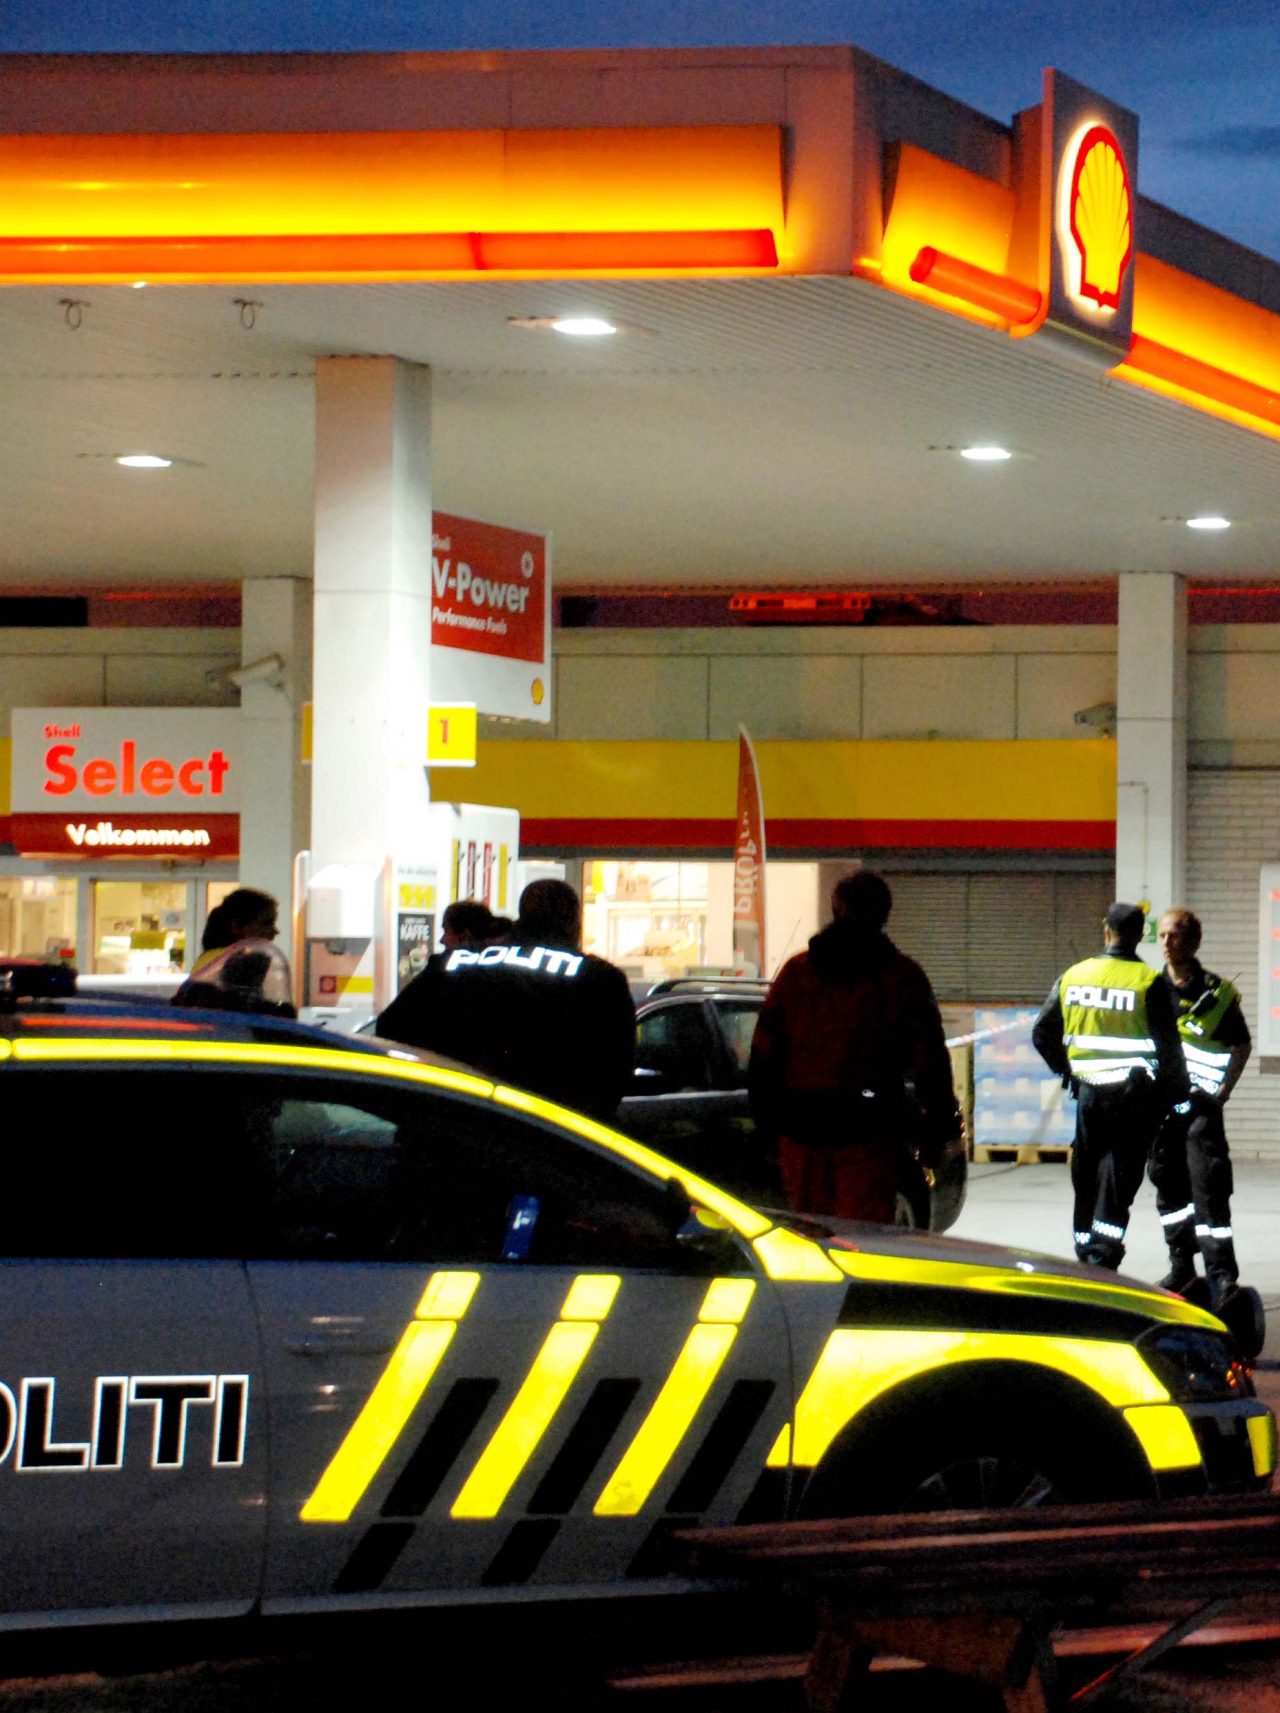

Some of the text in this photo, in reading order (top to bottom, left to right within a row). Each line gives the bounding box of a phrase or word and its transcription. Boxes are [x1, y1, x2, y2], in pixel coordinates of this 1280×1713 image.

[431, 556, 530, 614] V-Power
[44, 723, 81, 740] Shell
[439, 718, 449, 745] 1
[43, 739, 230, 797] Select
[65, 821, 211, 846] Velkommen
[400, 923, 430, 941] KAFFE
[445, 945, 584, 976] POLITI
[1065, 985, 1136, 1011] POLITI
[0, 1374, 249, 1473] LITI
